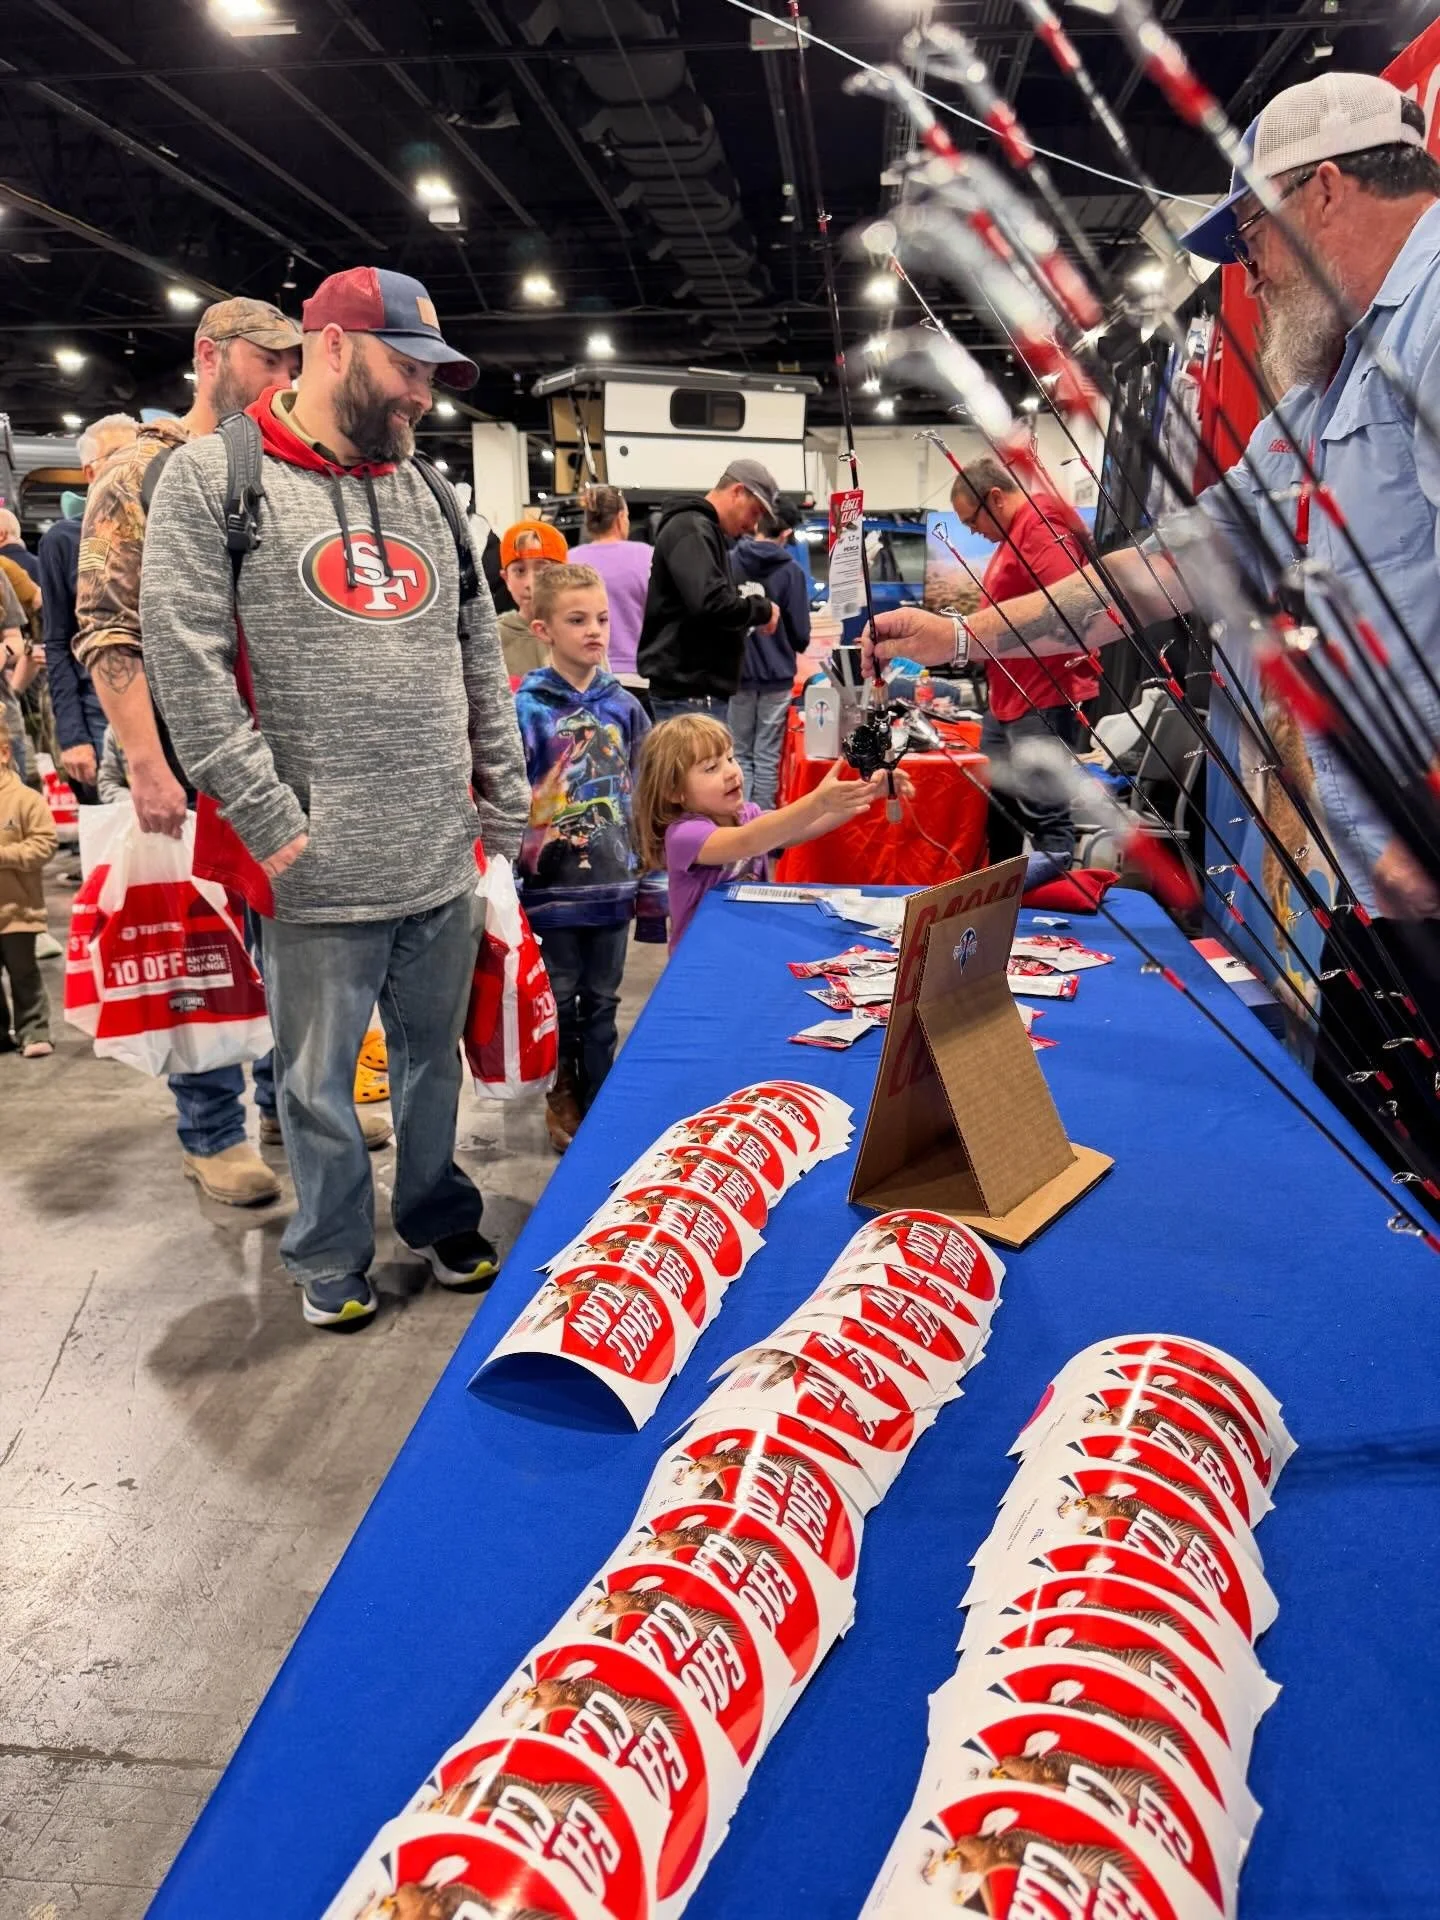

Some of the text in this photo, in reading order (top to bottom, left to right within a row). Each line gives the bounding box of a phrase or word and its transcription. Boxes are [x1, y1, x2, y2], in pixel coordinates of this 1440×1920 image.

[840, 497, 860, 512] EAGLE
[841, 509, 860, 523] CLAW
[143, 952, 183, 981] OFF
[186, 953, 222, 966] ANY OIL
[187, 961, 227, 973] CHANGE
[903, 1222, 945, 1266] CLAW
[939, 1230, 977, 1289] EAGLE
[568, 1282, 627, 1347] CLAW
[604, 1292, 662, 1373] EAGLE
